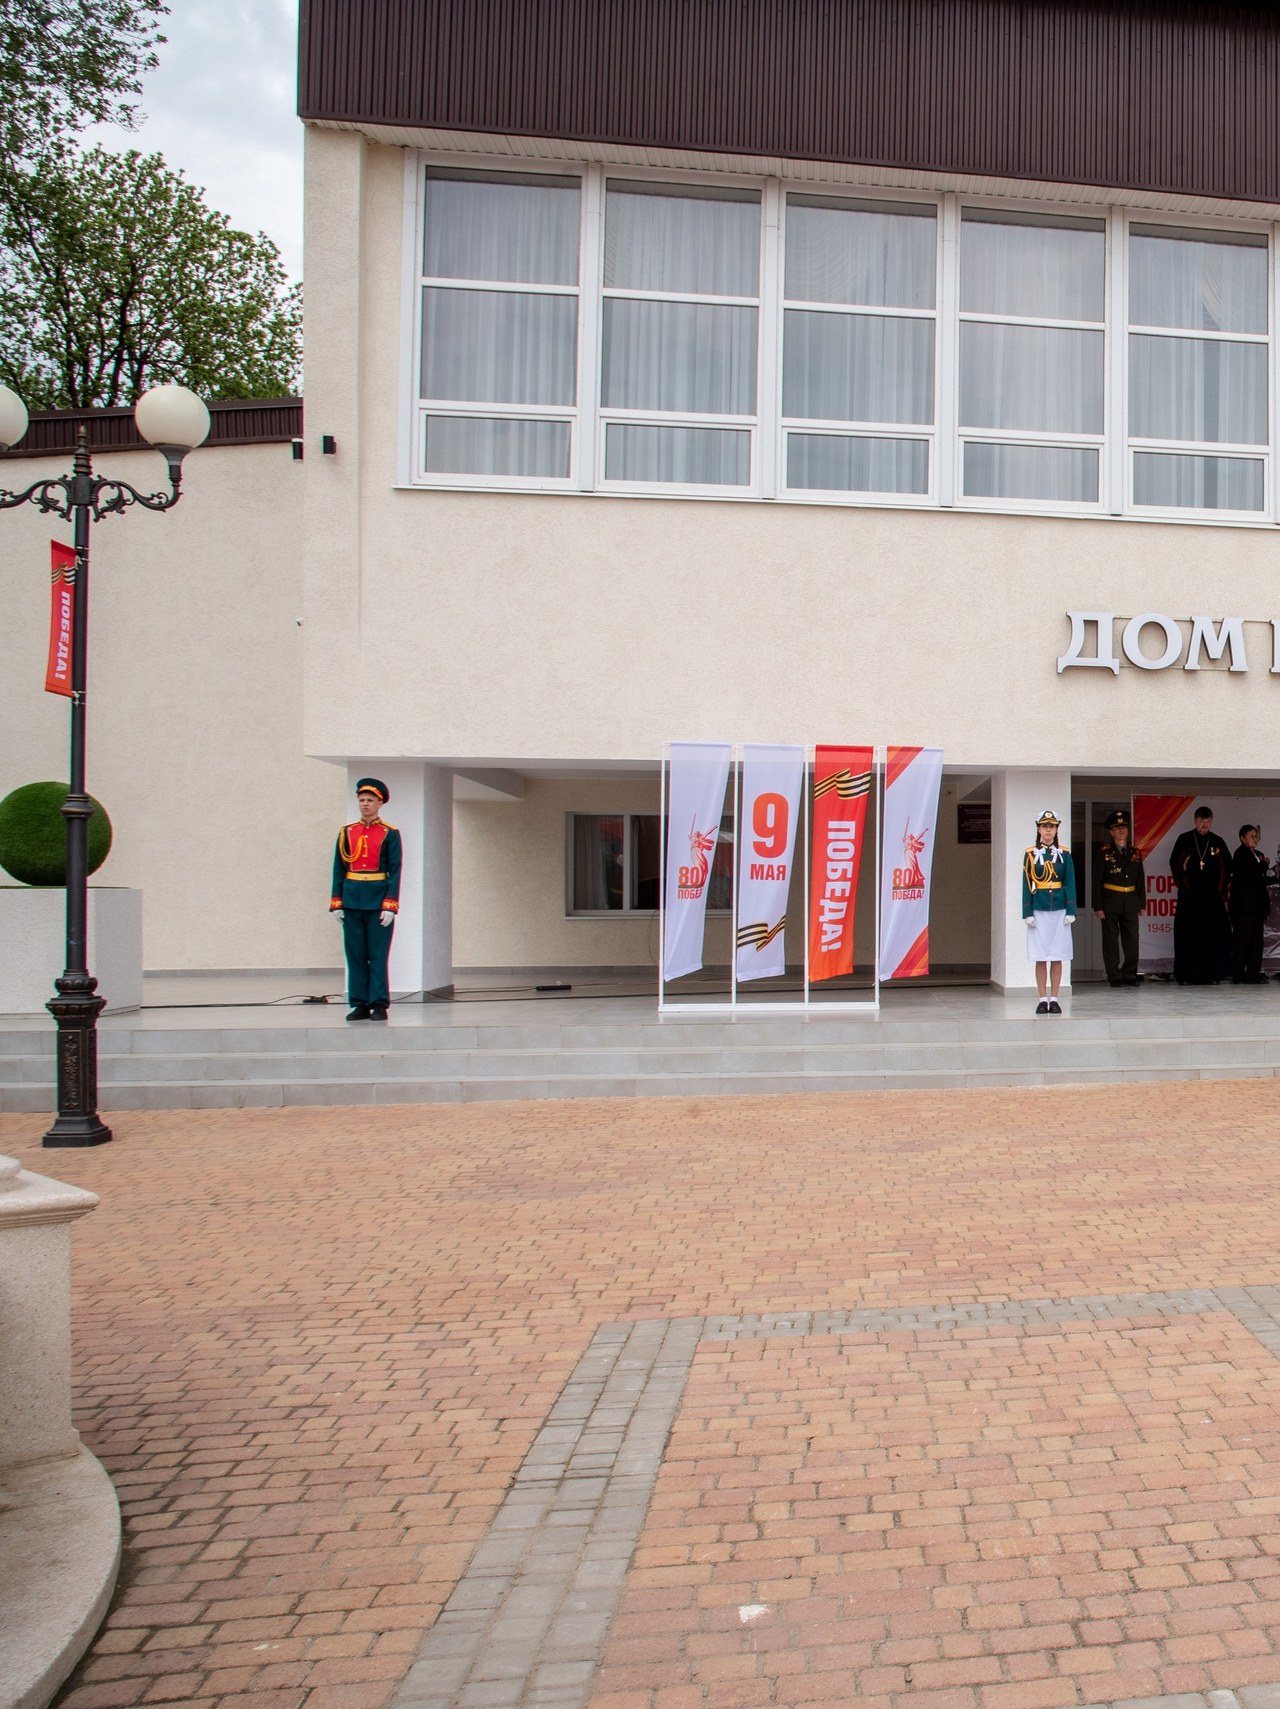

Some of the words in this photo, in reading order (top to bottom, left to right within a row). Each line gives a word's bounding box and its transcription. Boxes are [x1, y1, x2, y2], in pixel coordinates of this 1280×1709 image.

[55, 591, 70, 680] ПОБЕДА!
[1056, 611, 1248, 675] ДОМ
[752, 792, 789, 858] 9
[678, 866, 700, 886] 80
[750, 864, 786, 881] МАЯ
[892, 868, 912, 887] 80
[819, 820, 856, 953] ПОБЕДА!
[1146, 875, 1176, 893] ГОР
[892, 889, 924, 901] ПОБЕДА!
[1146, 898, 1178, 917] ПОБ
[1147, 924, 1174, 933] 1945-
